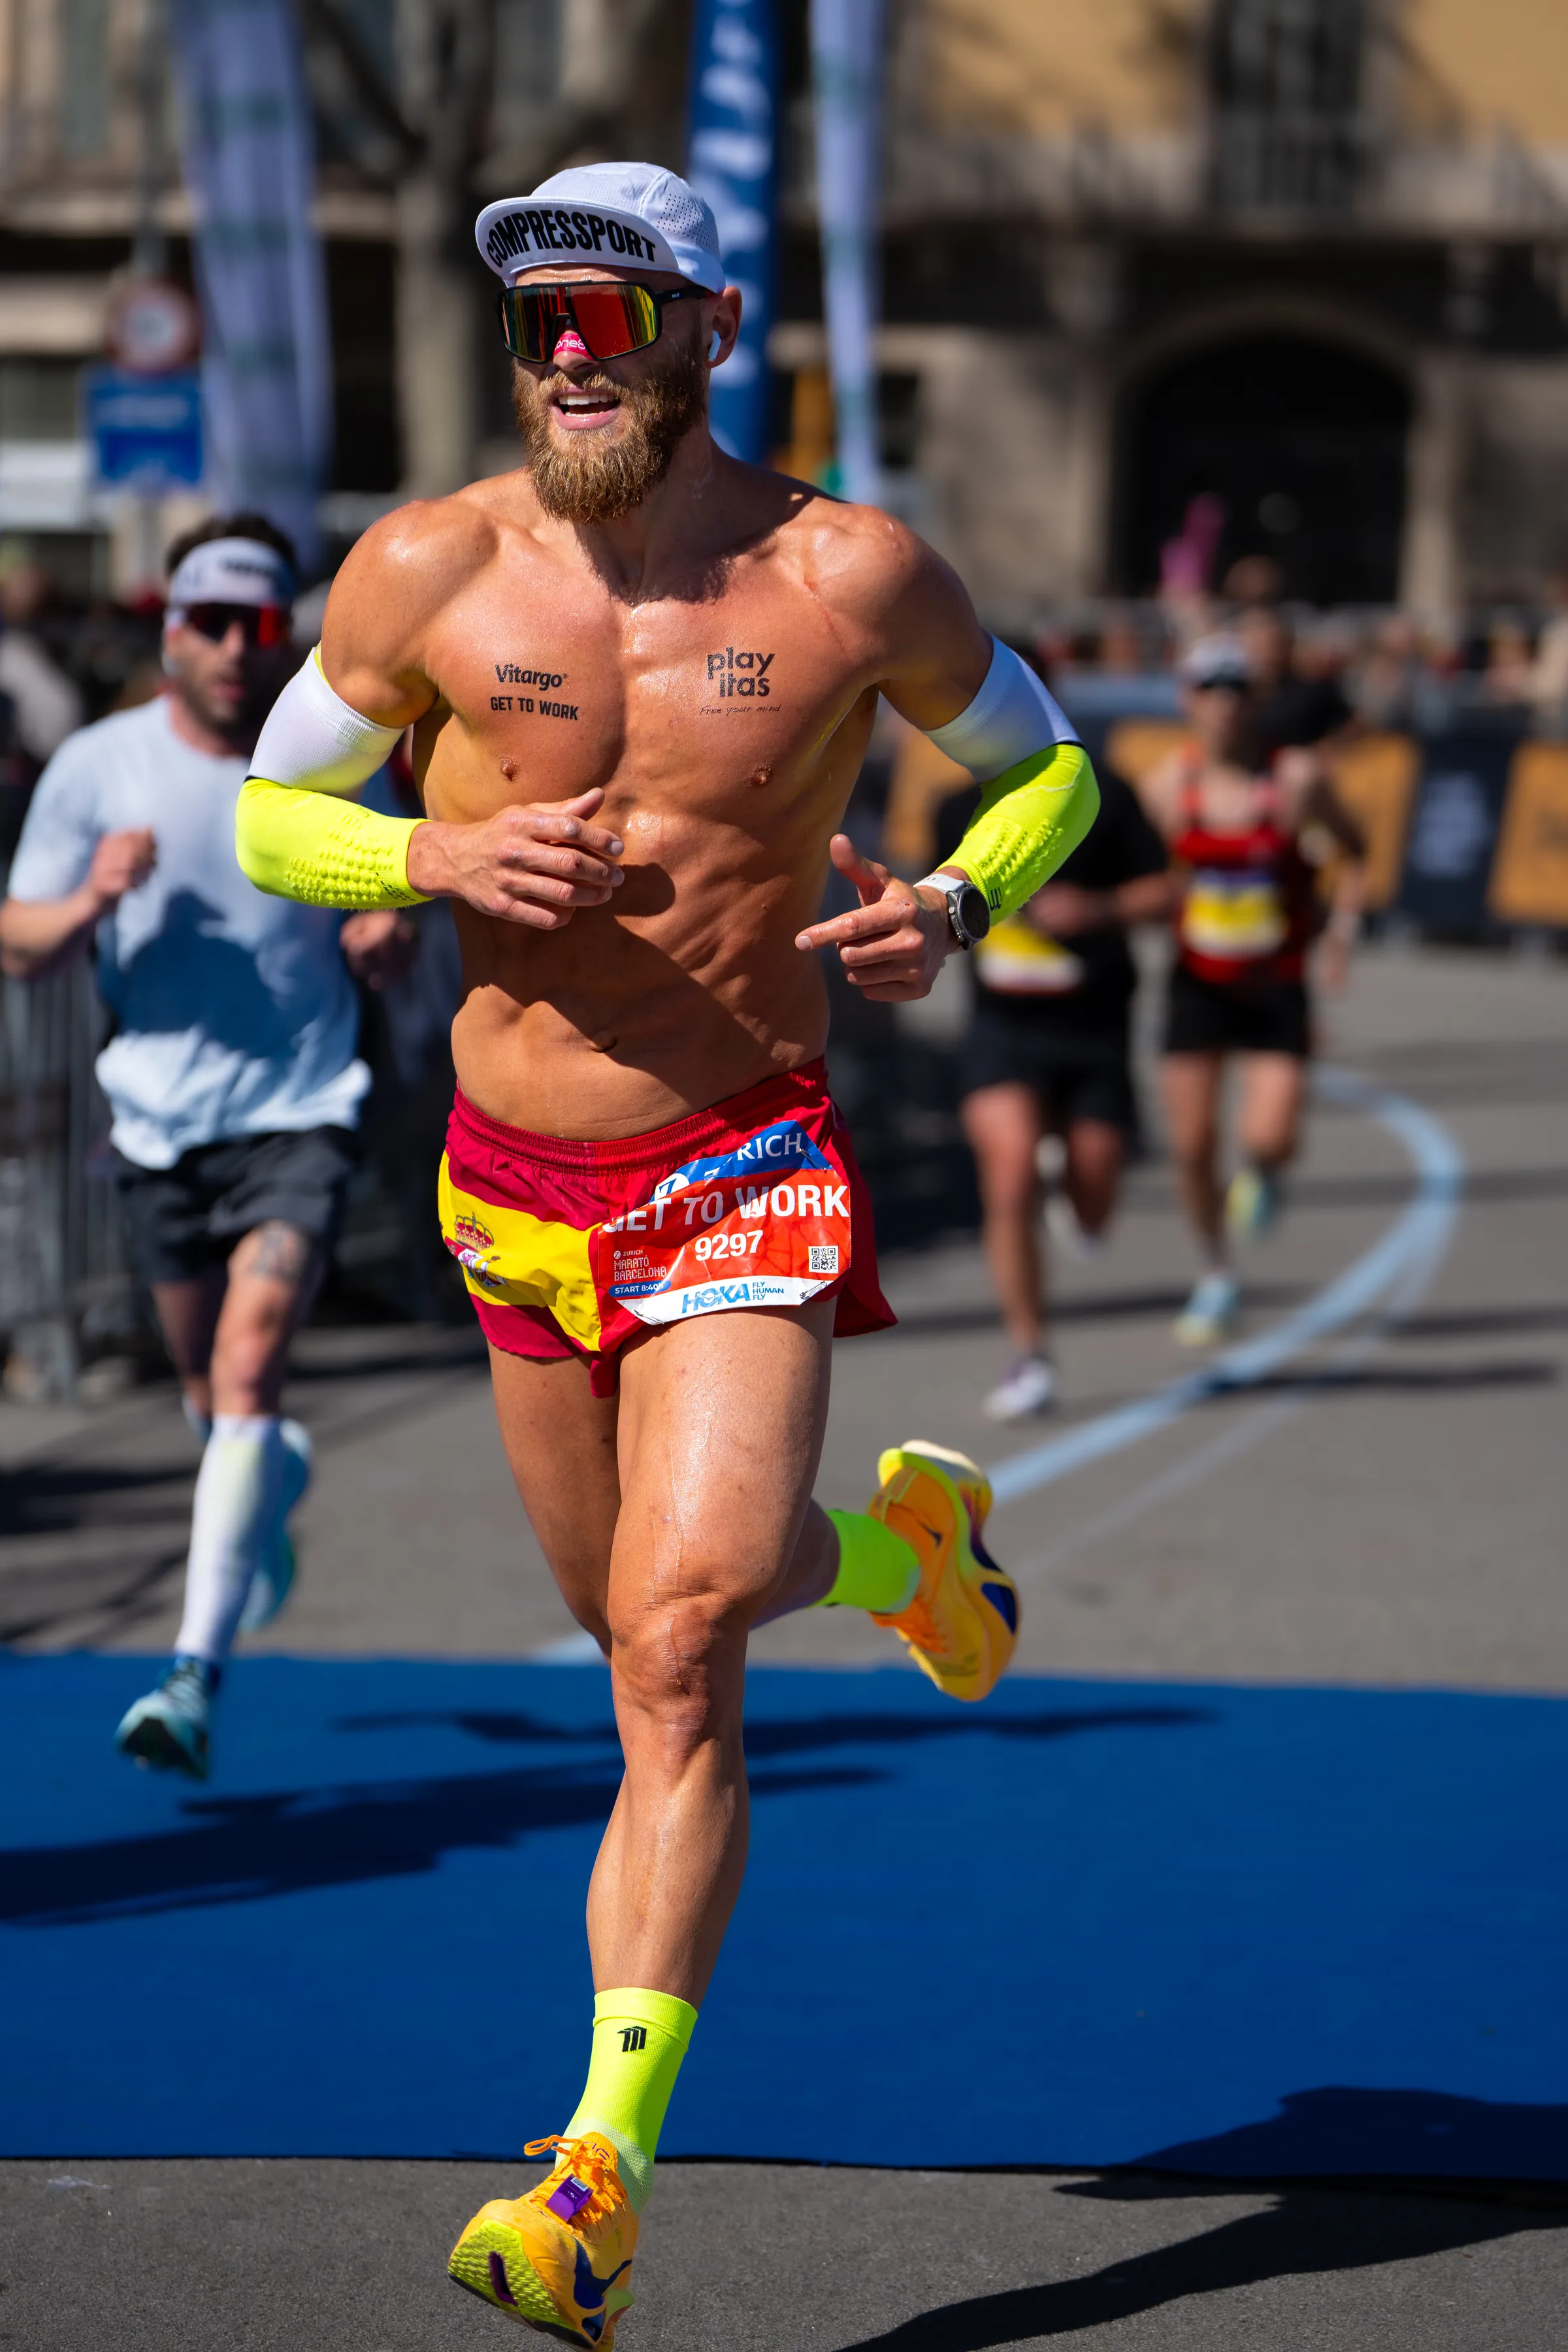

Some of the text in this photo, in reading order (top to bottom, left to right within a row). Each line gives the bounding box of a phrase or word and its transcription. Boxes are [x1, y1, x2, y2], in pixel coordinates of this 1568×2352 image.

[487, 210, 655, 268] COMPRESSPORT
[708, 647, 776, 679] play
[490, 696, 579, 721] GET TO WORK
[700, 705, 722, 715] Free
[726, 706, 751, 717] your
[683, 1191, 723, 1225] TO
[735, 1184, 849, 1219] WORK
[694, 1230, 763, 1262] 9297
[614, 1255, 649, 1271] MARATÓ
[615, 1285, 640, 1294] START
[681, 1283, 751, 1314] HOKA
